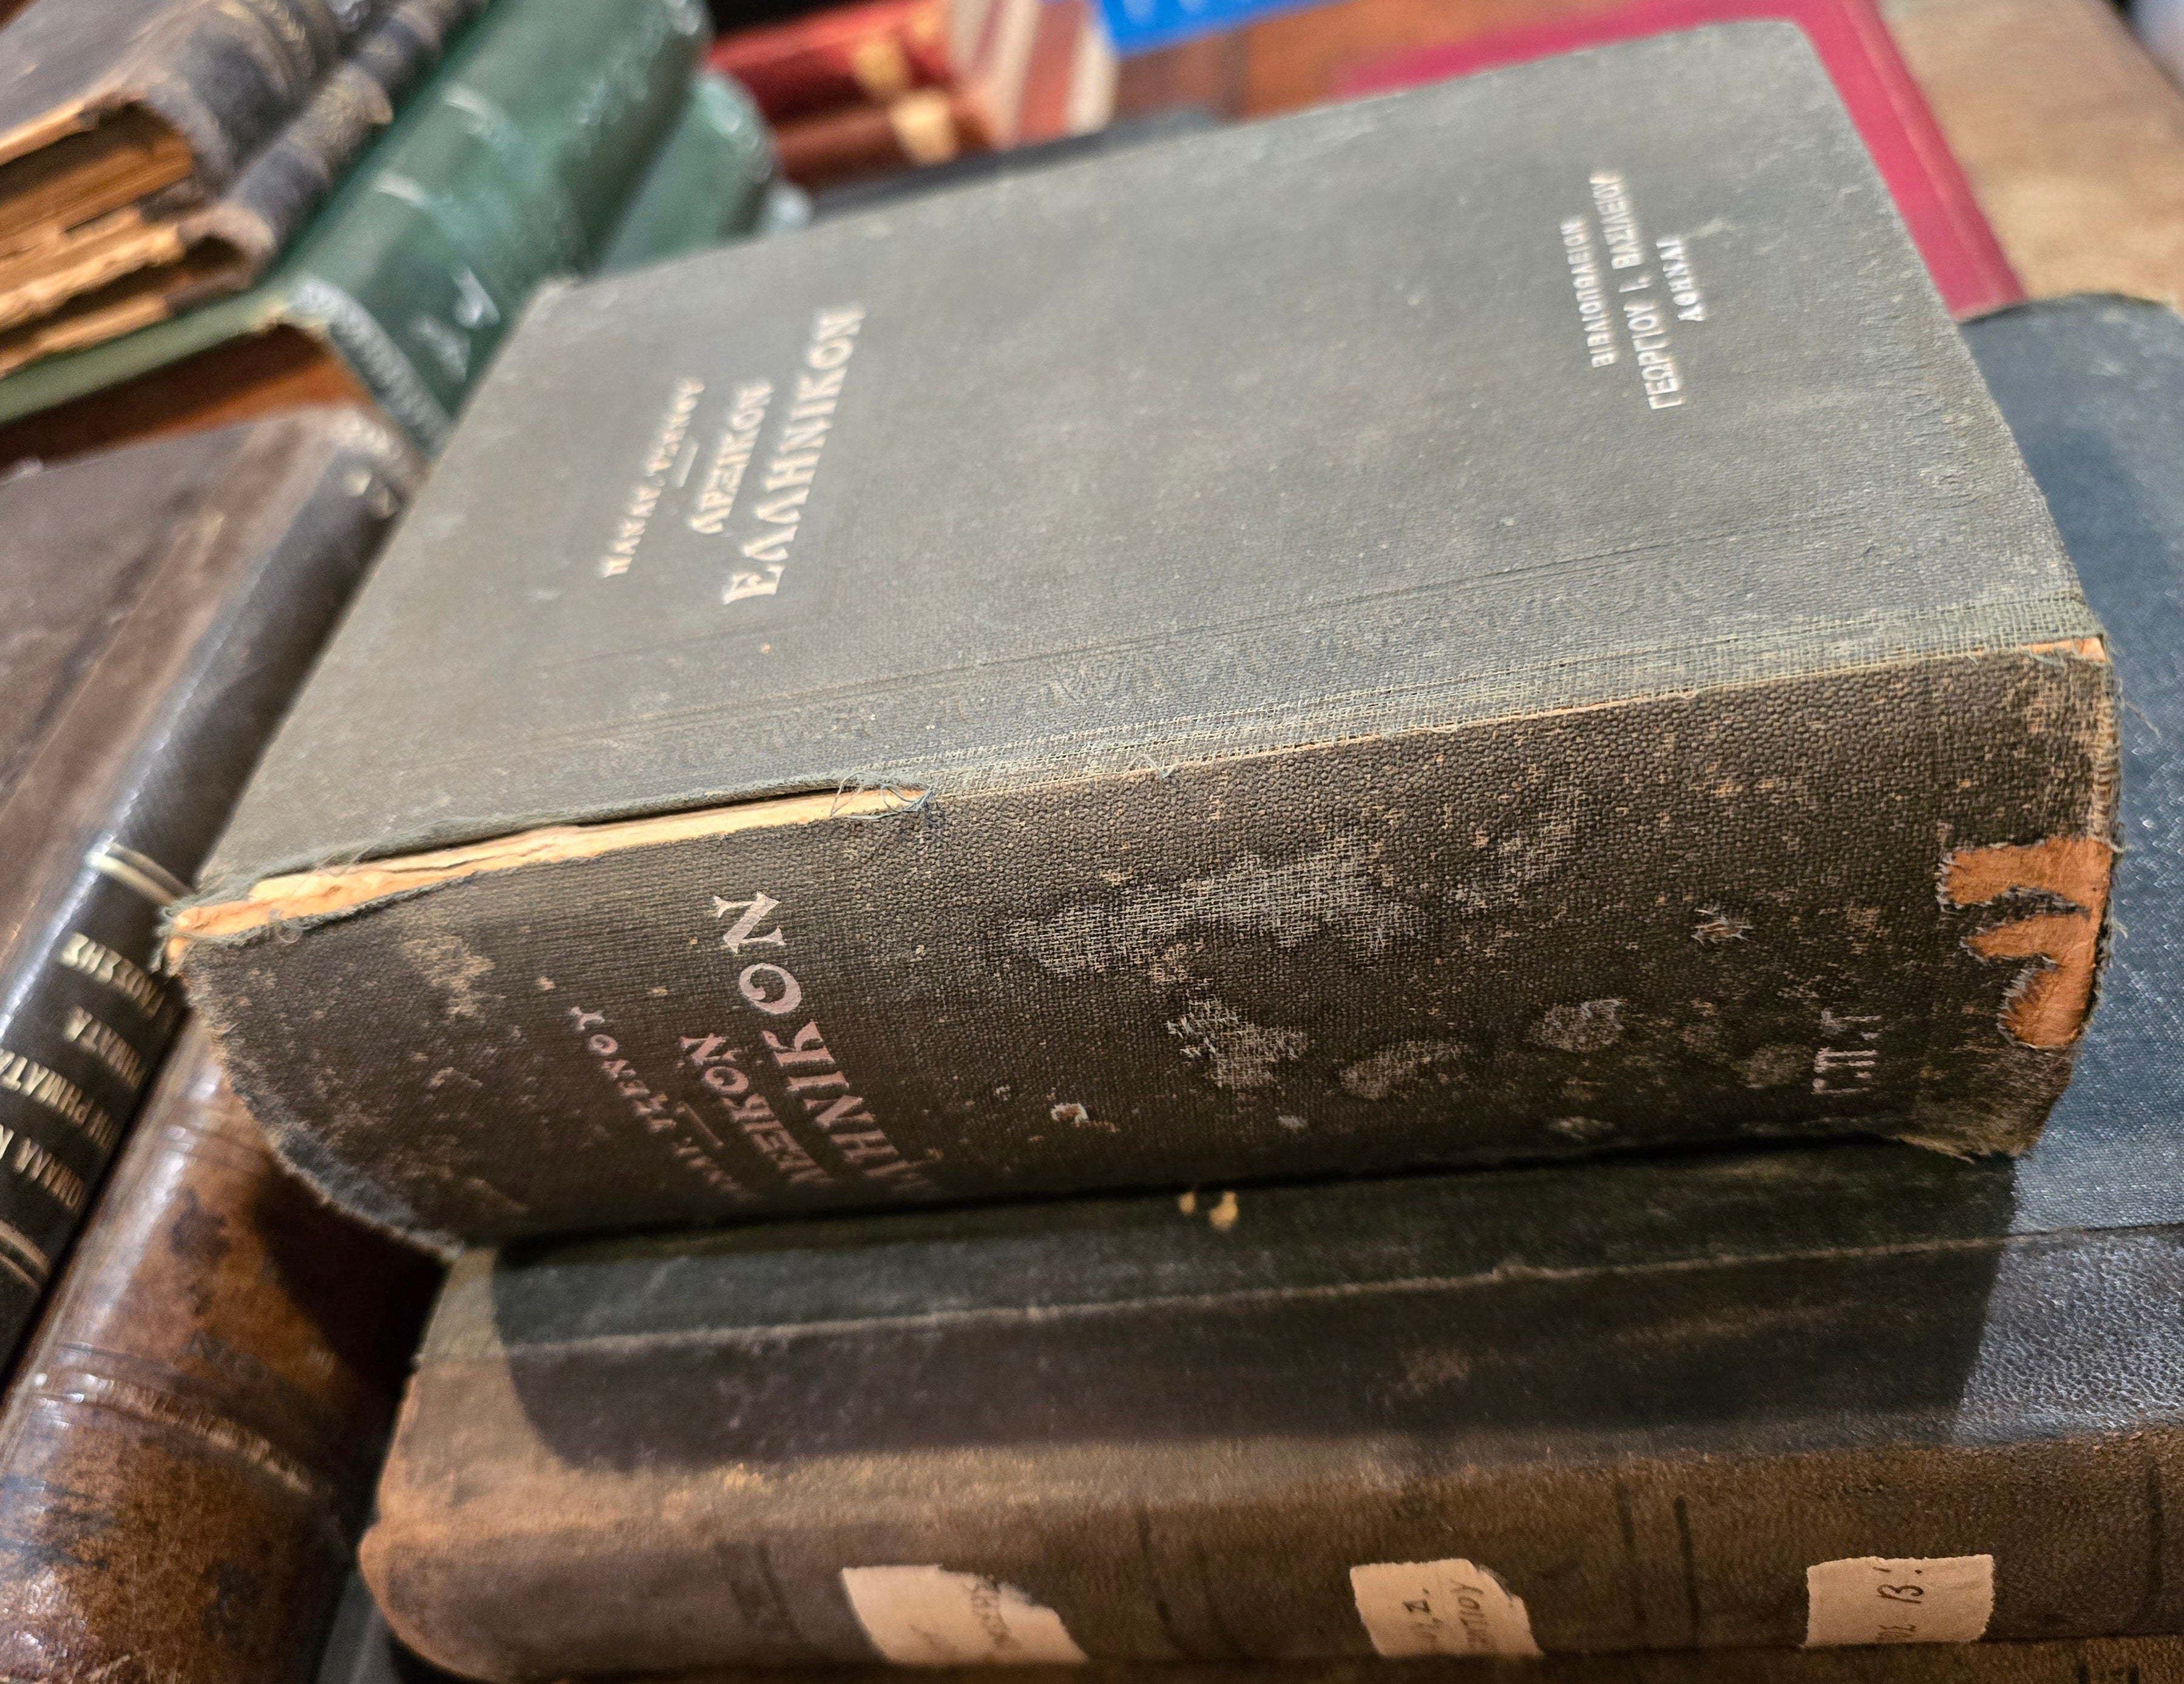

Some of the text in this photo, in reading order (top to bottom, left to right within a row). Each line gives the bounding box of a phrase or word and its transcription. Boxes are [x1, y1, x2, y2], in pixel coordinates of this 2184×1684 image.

[1560, 216, 1619, 368] ΒΙΒΛΙΟΠΩΛΕΙΟΝ
[1589, 169, 1644, 270] ΒΑΣΙΛΕΙΟΥ
[1623, 301, 1687, 410] ΓΕΩΡΓΙΟΥ
[687, 378, 775, 534] ΛΕΞΙΚΟΝ
[722, 304, 866, 605] ΕΛΛΗΝΙΚΟΝ
